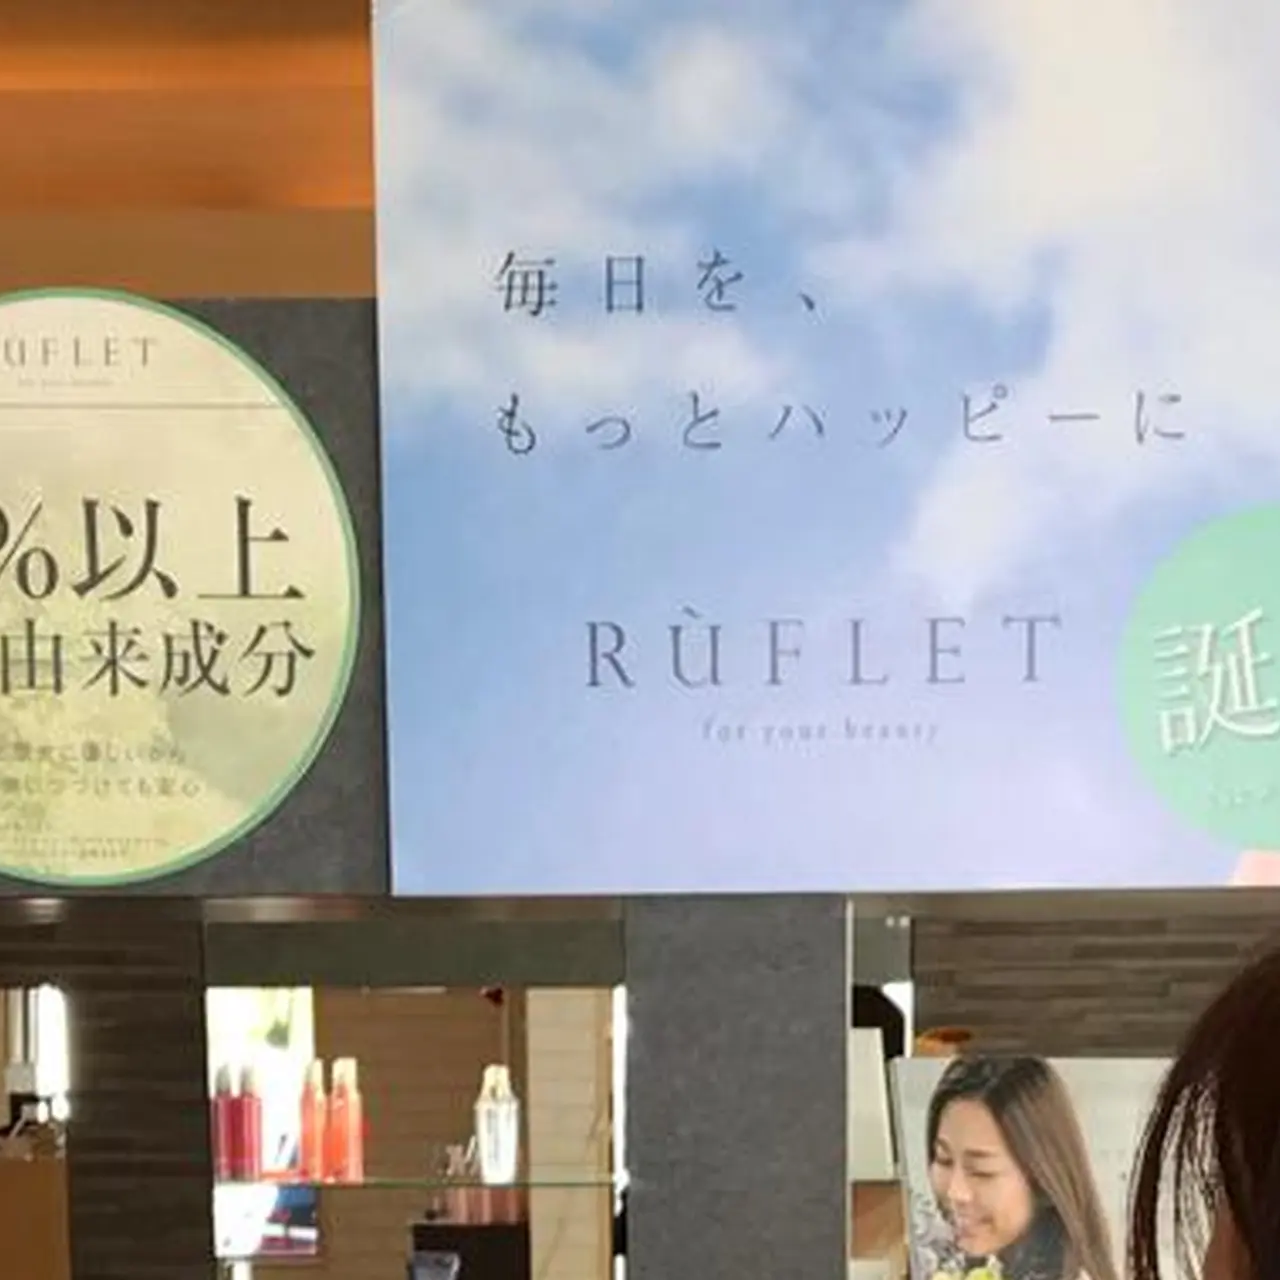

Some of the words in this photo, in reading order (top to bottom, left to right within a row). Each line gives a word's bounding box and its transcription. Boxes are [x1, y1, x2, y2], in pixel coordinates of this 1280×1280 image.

[496, 250, 818, 317] 毎日を、
[496, 382, 1187, 456] もっとハッピーに
[584, 606, 1062, 690] RÙFLET
